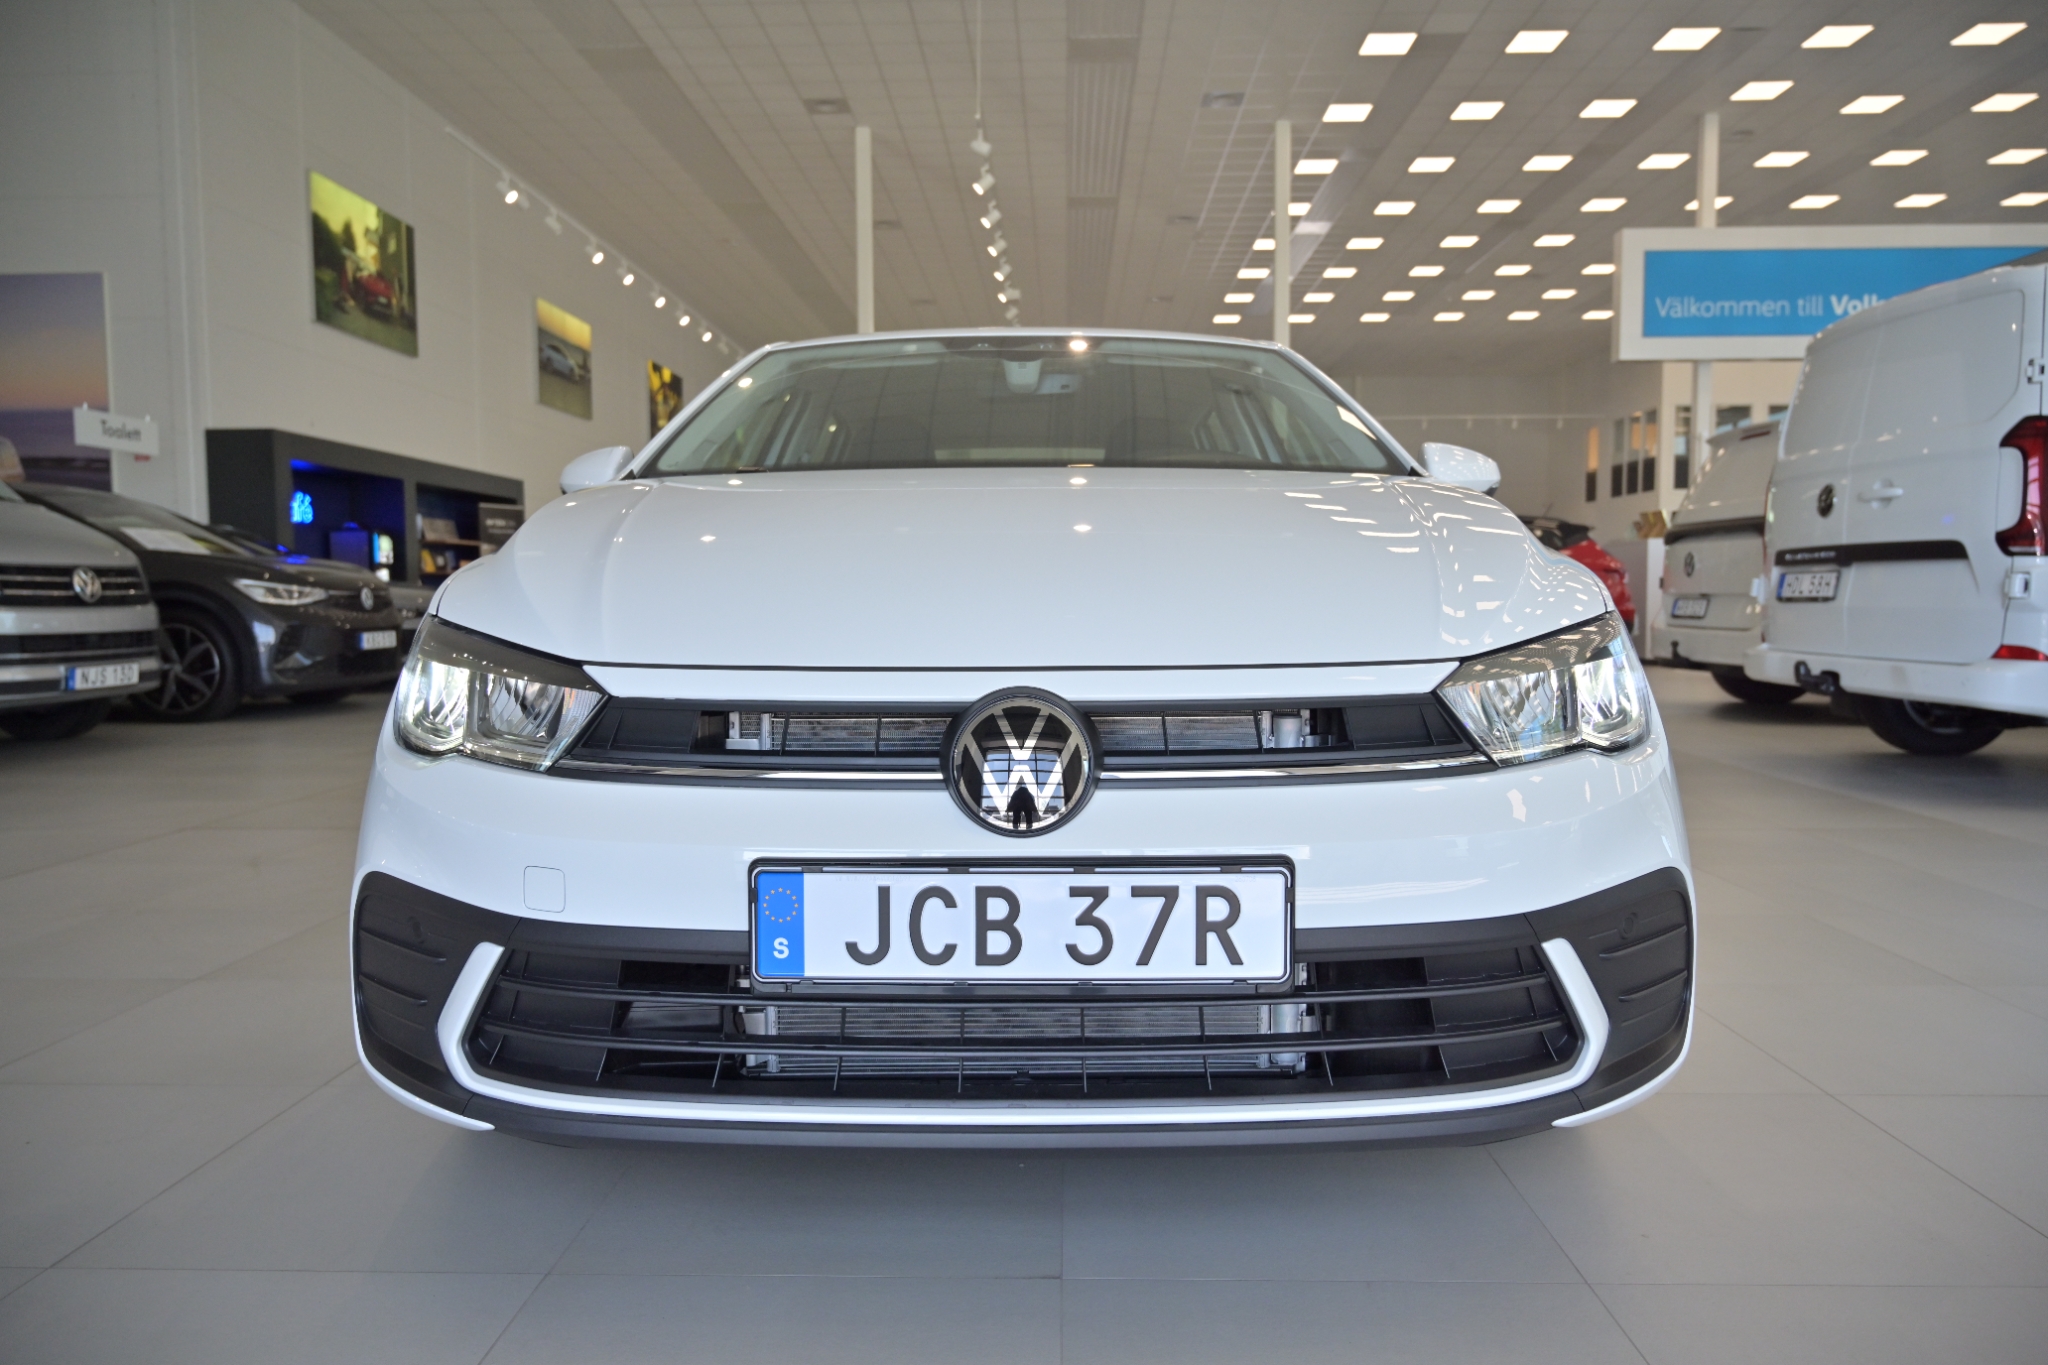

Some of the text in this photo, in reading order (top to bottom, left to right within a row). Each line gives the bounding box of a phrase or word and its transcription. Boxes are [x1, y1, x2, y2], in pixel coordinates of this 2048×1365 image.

[1655, 295, 1790, 318] Välkommen
[1797, 295, 1823, 316] till
[773, 885, 1244, 966] S JCB 37R
